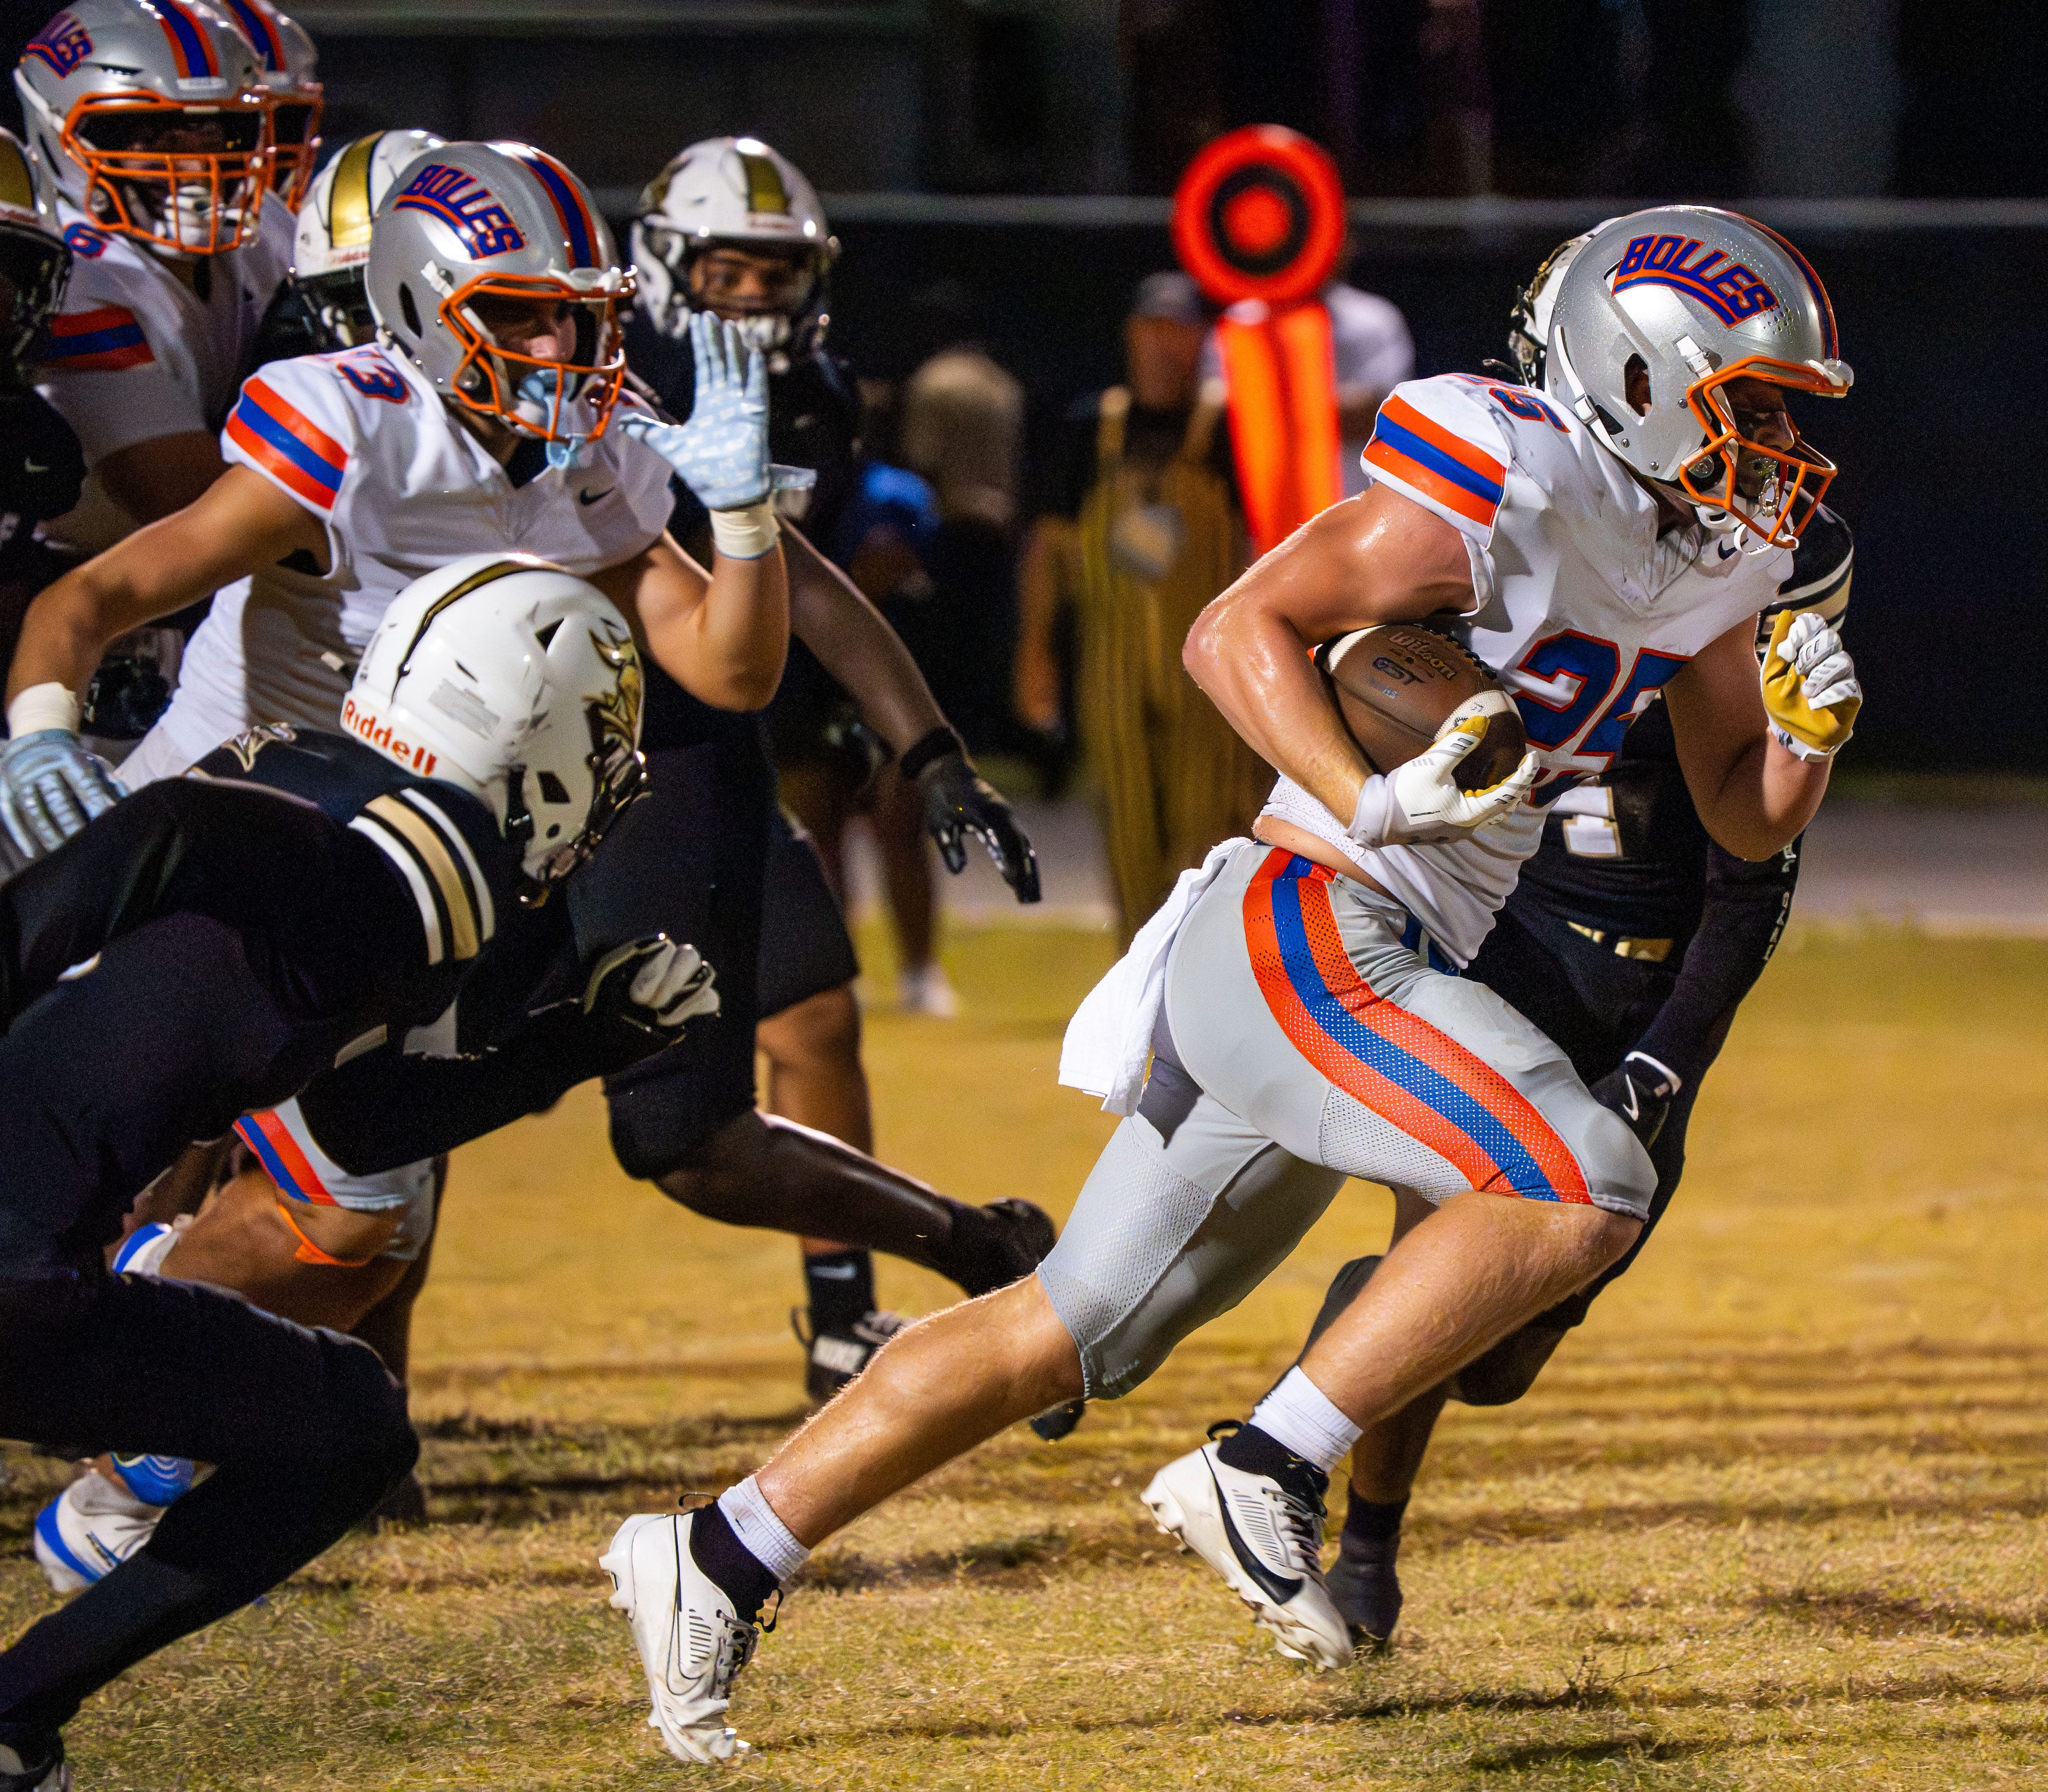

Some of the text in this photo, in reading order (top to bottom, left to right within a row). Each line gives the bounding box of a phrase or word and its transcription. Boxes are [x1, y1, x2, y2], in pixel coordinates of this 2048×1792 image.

[402, 163, 525, 258] BOLLES
[1617, 234, 1779, 322] BOLLES
[1390, 631, 1457, 681] Wilson
[343, 699, 437, 777] Riddell
